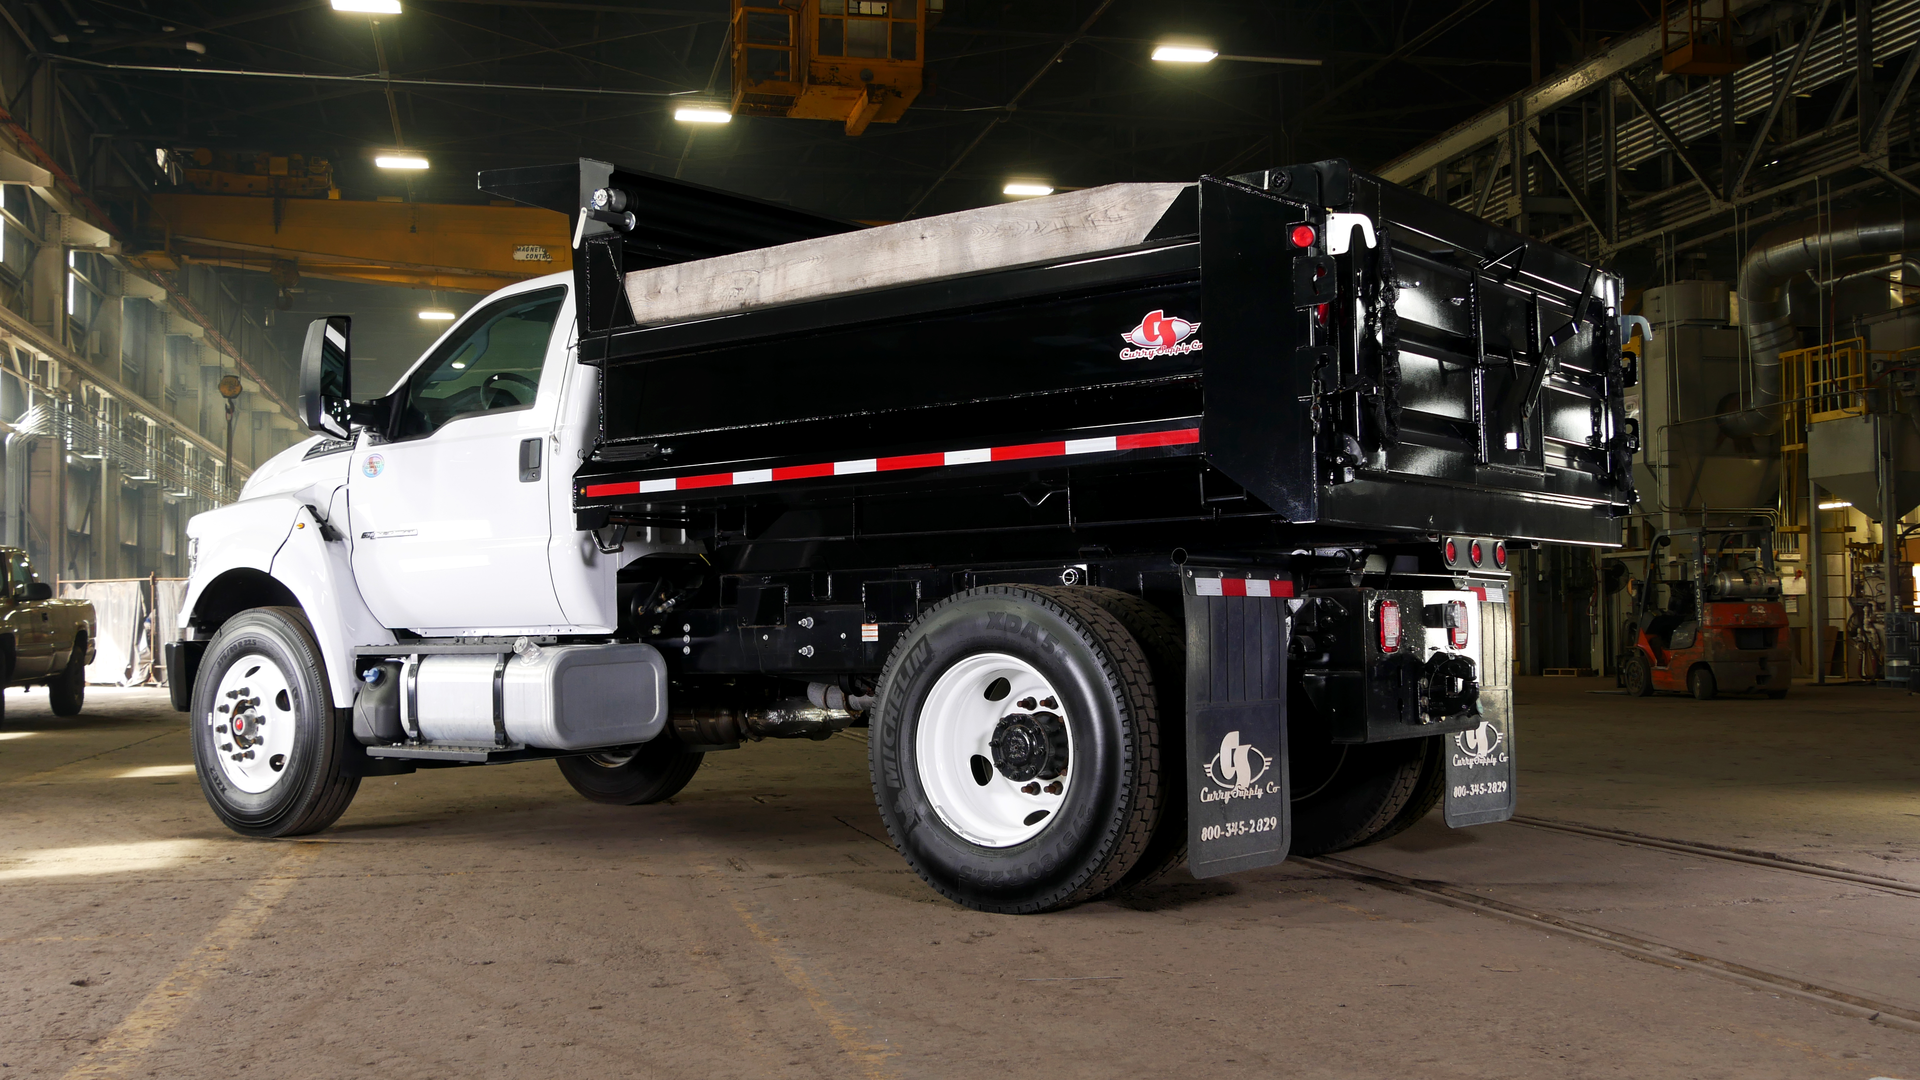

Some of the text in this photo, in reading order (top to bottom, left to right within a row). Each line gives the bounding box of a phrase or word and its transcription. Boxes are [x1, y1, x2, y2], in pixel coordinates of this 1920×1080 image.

[1120, 347, 1156, 360] Curry
[1156, 343, 1191, 356] Supply
[882, 636, 929, 789] MICHELIN
[1452, 753, 1475, 769] Curry
[1474, 752, 1498, 767] Supply
[1200, 781, 1280, 805] Curry Supply Co
[1453, 780, 1507, 799] 800-345-2829
[1200, 816, 1278, 842] 800-345-2829
